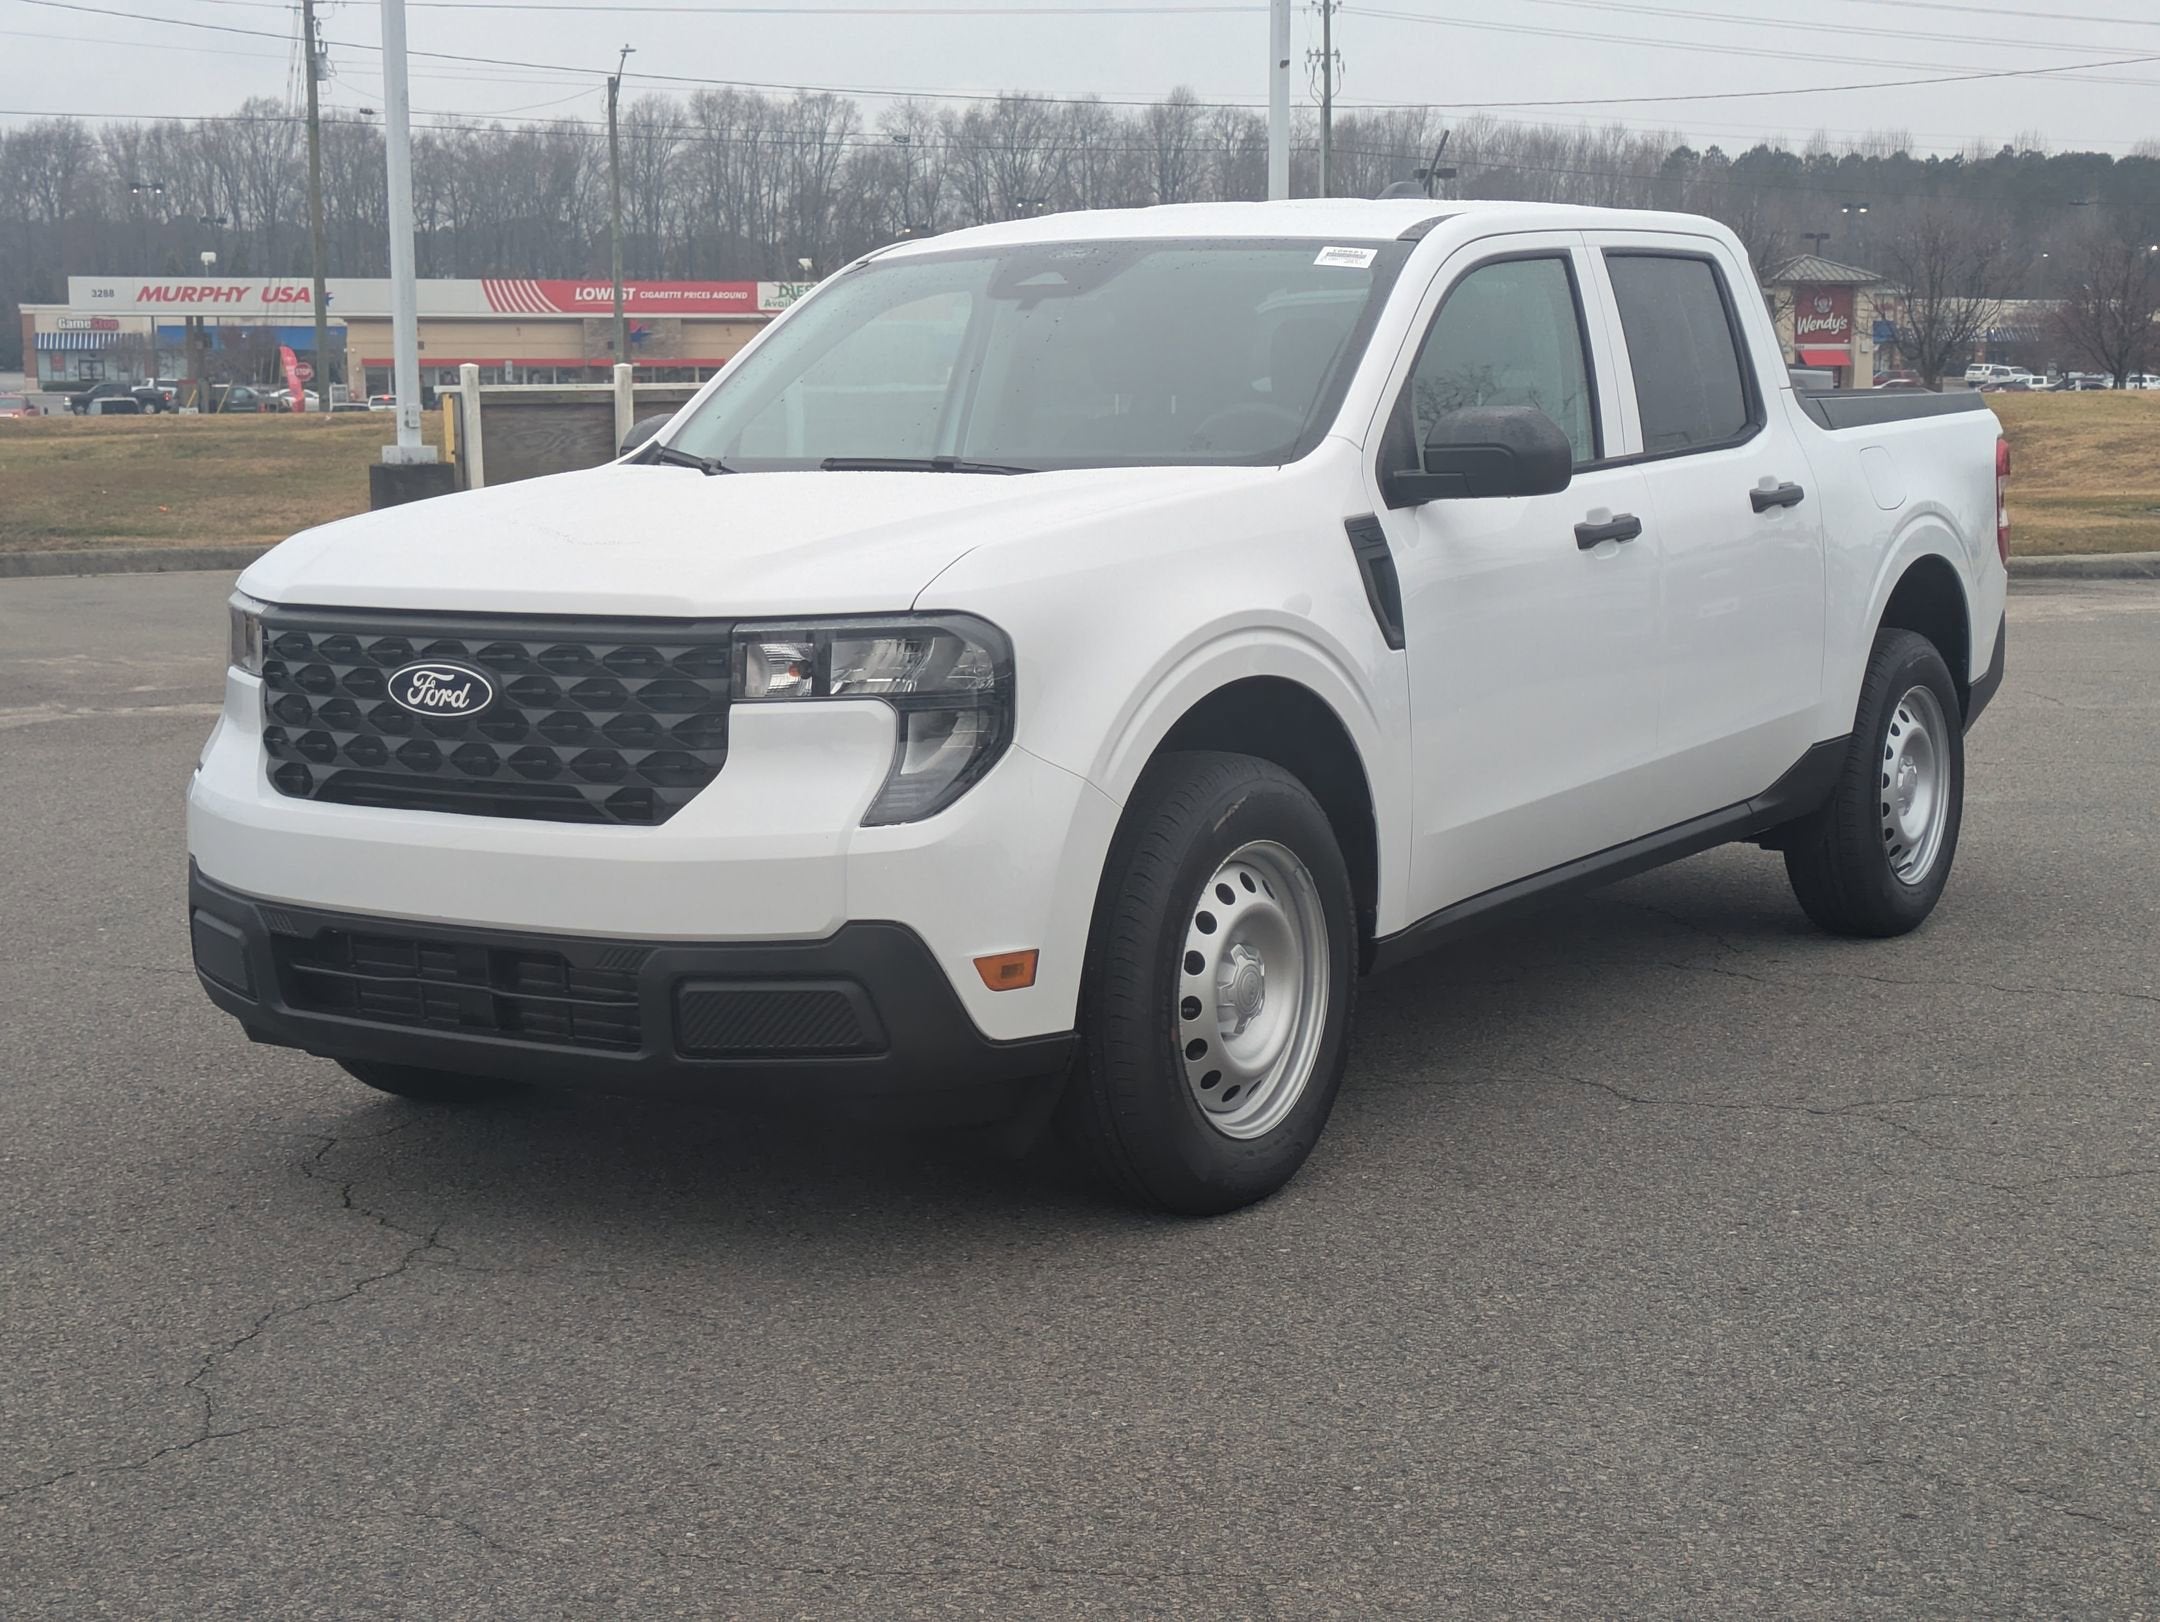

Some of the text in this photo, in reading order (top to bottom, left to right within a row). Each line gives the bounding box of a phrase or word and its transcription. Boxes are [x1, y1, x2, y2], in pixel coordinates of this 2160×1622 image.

[91, 289, 115, 298] 3288
[136, 286, 311, 303] MURPHY USA
[640, 291, 681, 299] CIGARETTE
[684, 291, 710, 299] PRICES
[712, 291, 748, 299] AROUND
[58, 318, 118, 330] GameStop
[1797, 312, 1848, 335] Wendy's
[296, 368, 312, 376] STOP
[407, 670, 471, 708] Ford
